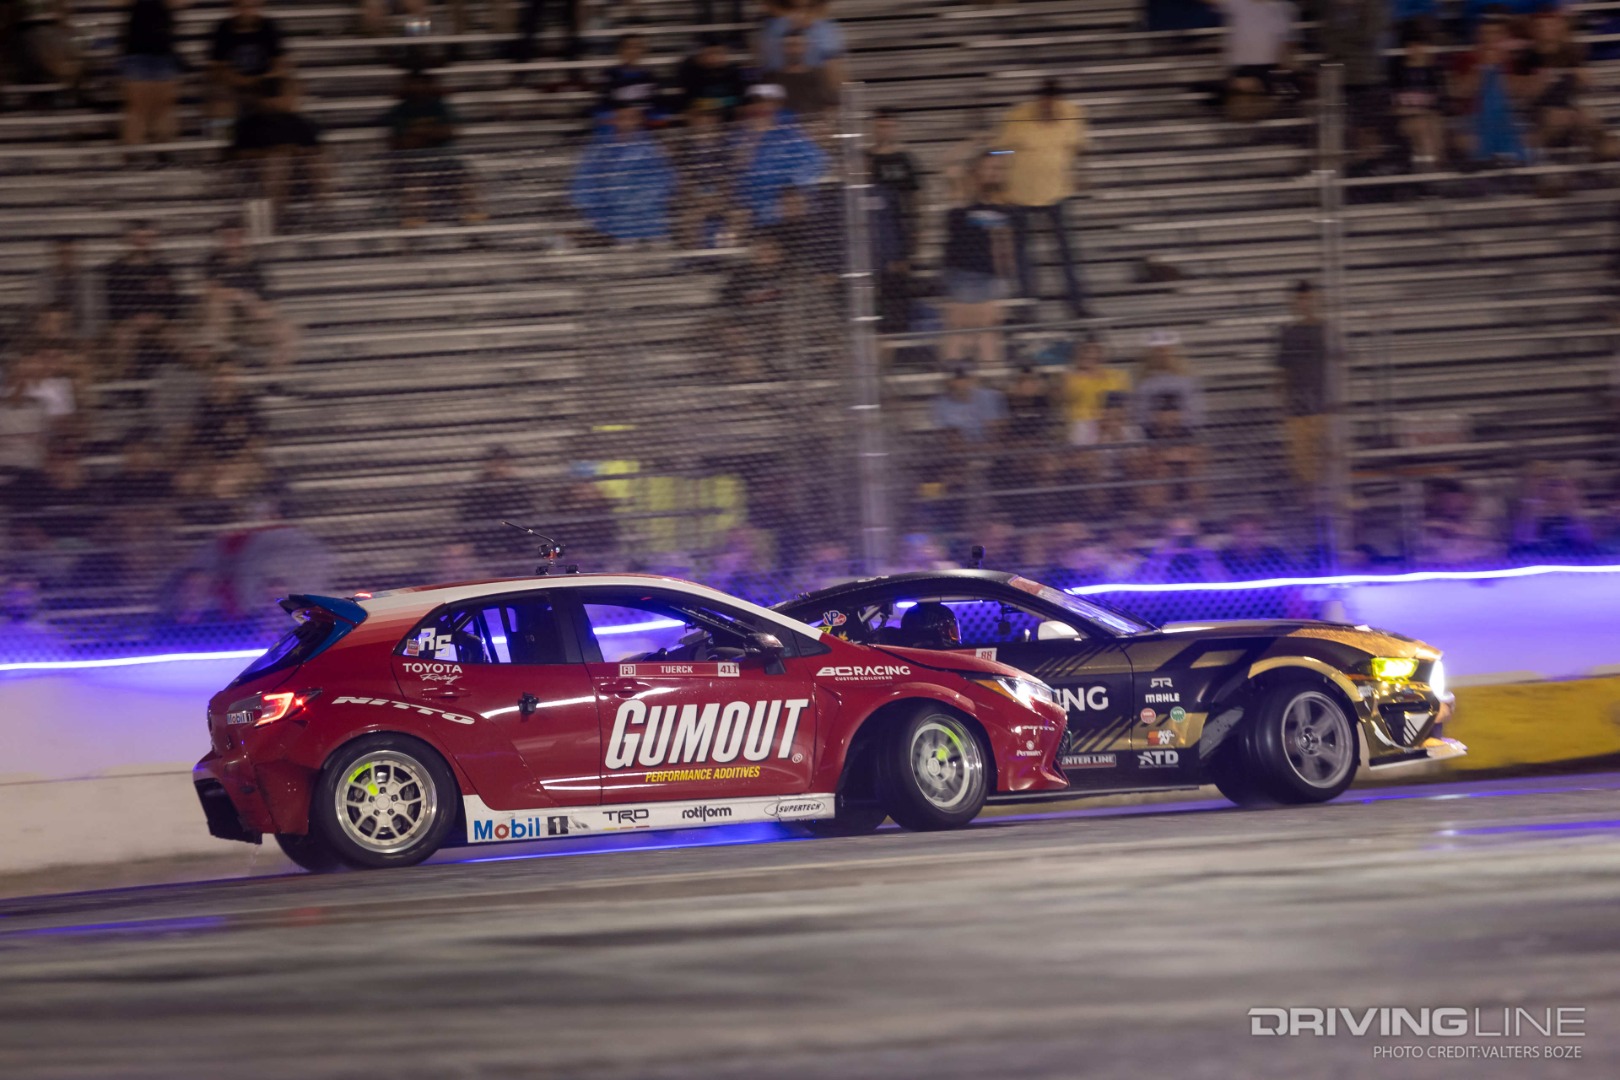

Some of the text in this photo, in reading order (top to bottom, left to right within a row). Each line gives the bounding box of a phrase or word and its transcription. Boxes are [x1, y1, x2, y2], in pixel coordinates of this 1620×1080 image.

[419, 628, 452, 657] RS
[402, 663, 463, 673] TOYOTA
[622, 666, 634, 675] FD
[660, 665, 693, 674] TUERCK
[720, 665, 737, 674] 411
[1145, 692, 1180, 703] MAHLE
[331, 696, 475, 725] NITTO
[1093, 755, 1115, 764] LINE
[645, 766, 760, 783] PERFORMANCE ADDITIVES
[603, 809, 649, 824] TRD
[682, 805, 732, 822] rotiform
[474, 818, 540, 840] Mobil
